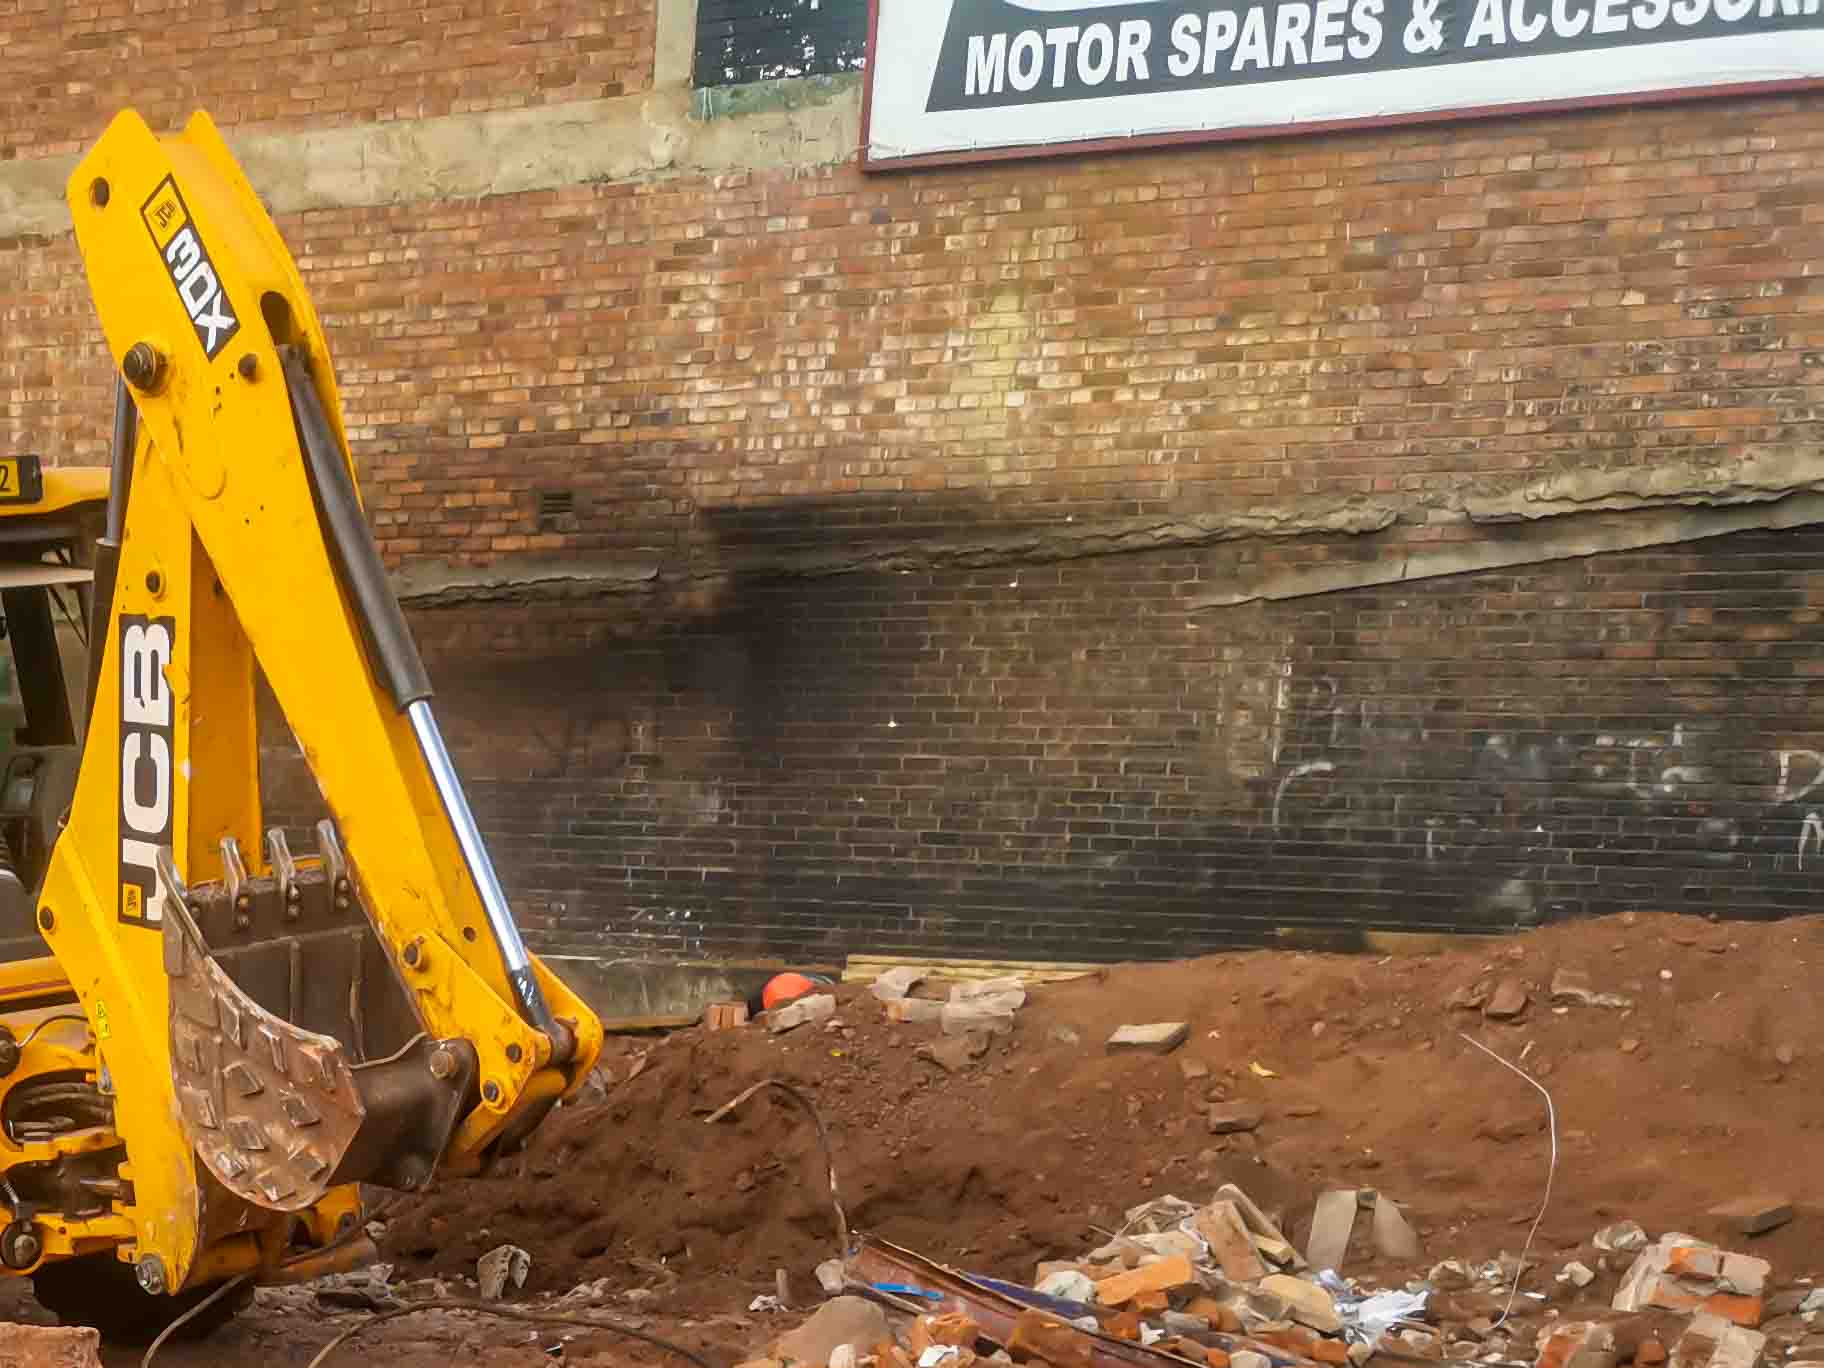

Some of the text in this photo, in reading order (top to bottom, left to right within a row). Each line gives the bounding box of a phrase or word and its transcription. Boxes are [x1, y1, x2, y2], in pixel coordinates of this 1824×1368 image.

[964, 19, 1152, 96] MOTOR
[1167, 0, 1385, 77] SPARES
[1402, 0, 1444, 54] &
[165, 227, 237, 353] 3DX
[121, 623, 170, 921] JCB
